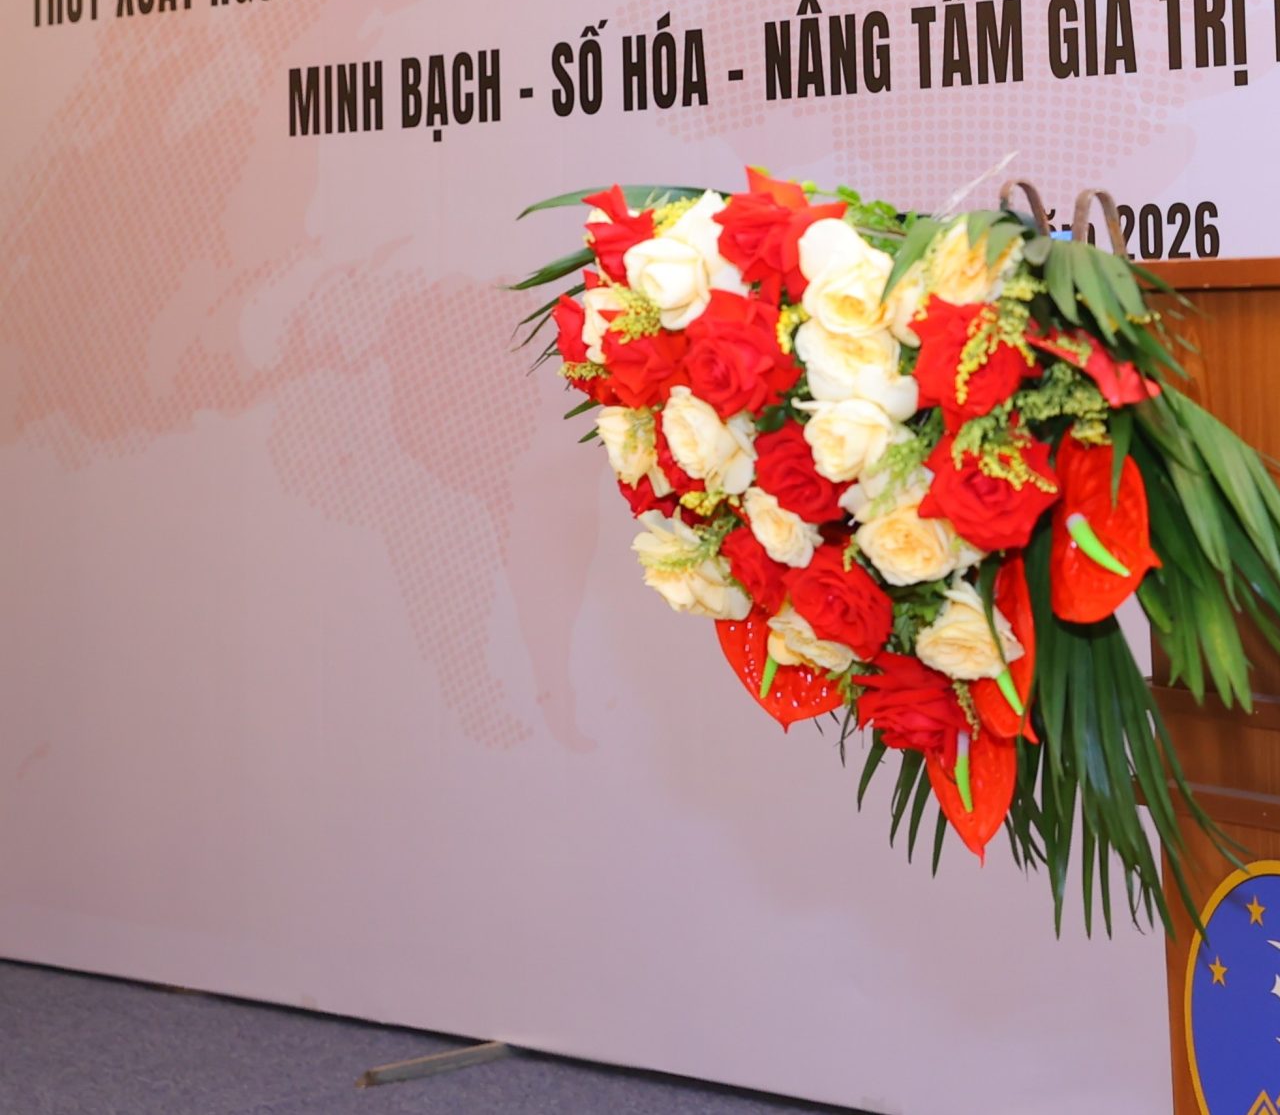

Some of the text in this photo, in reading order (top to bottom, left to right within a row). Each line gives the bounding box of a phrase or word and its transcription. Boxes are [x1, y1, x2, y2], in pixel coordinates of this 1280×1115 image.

[289, 60, 383, 137] MINH
[401, 49, 501, 142] BẠCH
[551, 19, 608, 117] SỐ
[622, 11, 709, 112] HÓA
[1116, 201, 1220, 261] 2026
